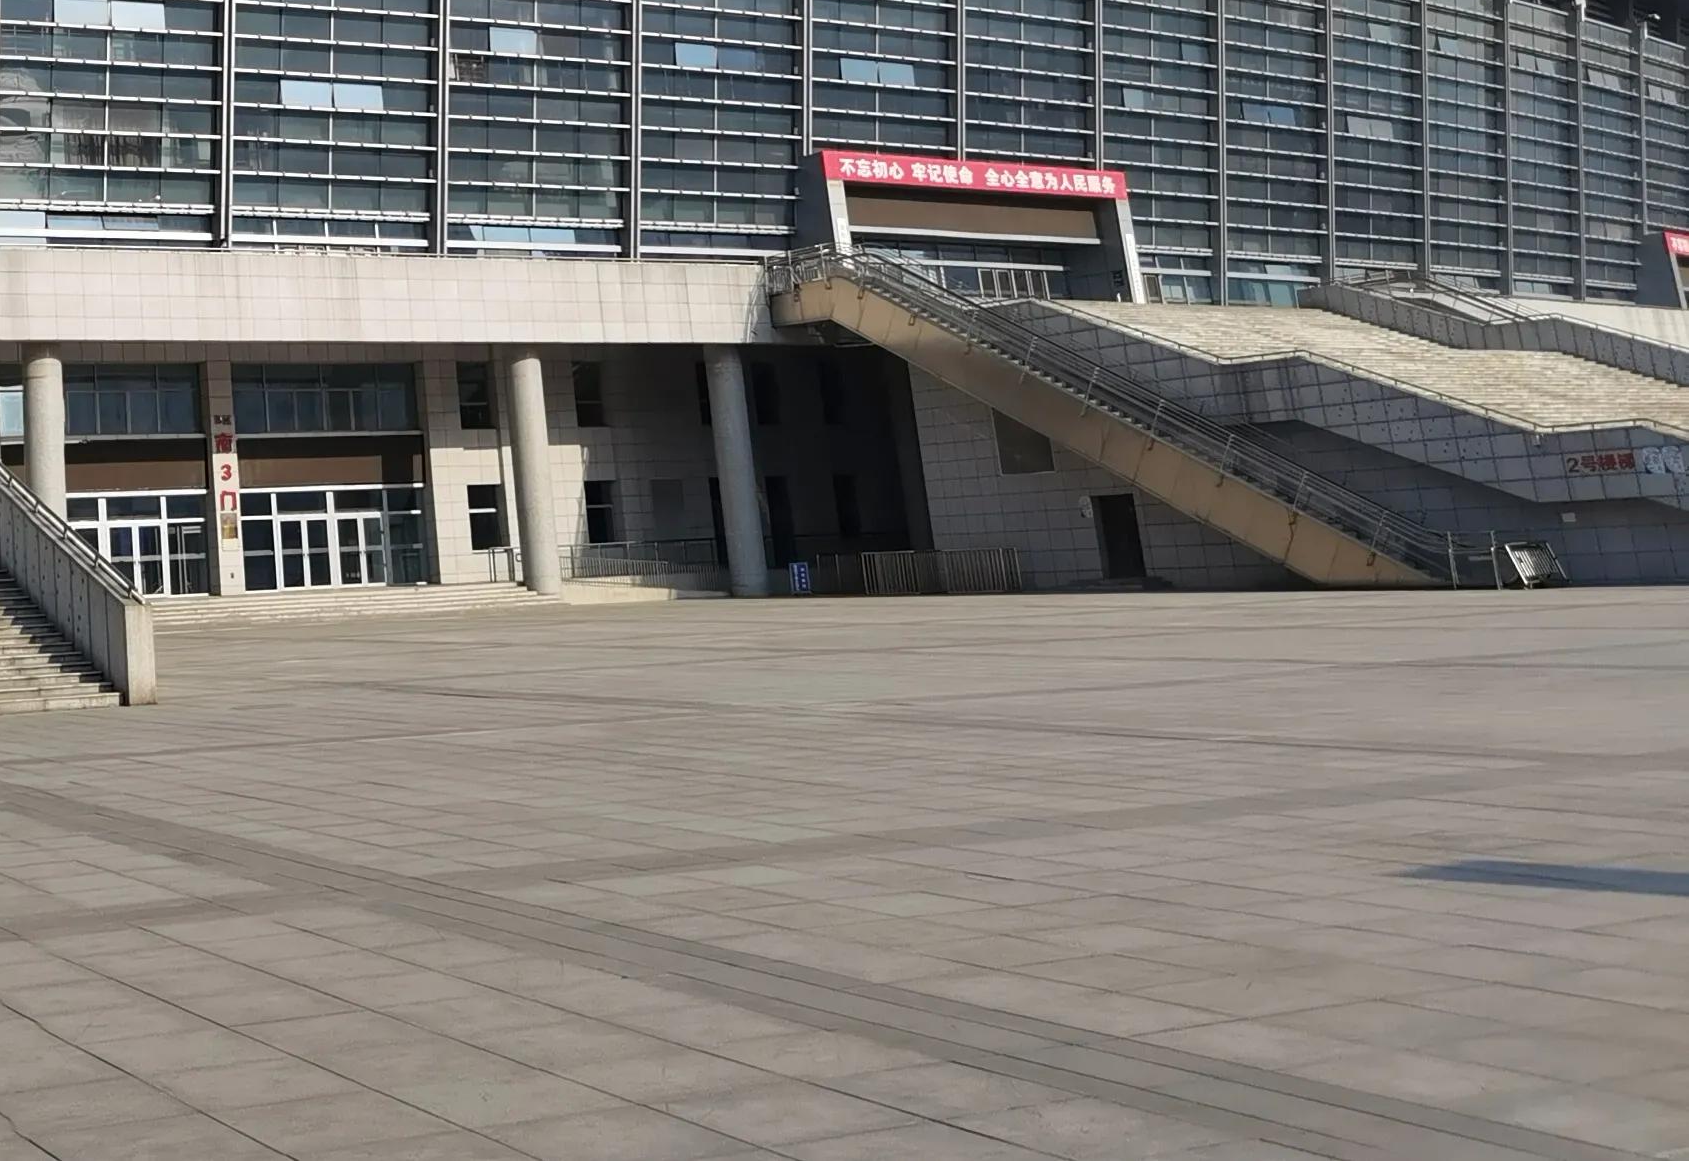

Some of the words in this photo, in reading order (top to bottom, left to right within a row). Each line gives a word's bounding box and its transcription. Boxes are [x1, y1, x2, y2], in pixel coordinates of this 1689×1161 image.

[839, 158, 904, 179] 不忘初心
[911, 163, 973, 185] 牢记使命
[984, 171, 1116, 194] 全心全意为人民服务
